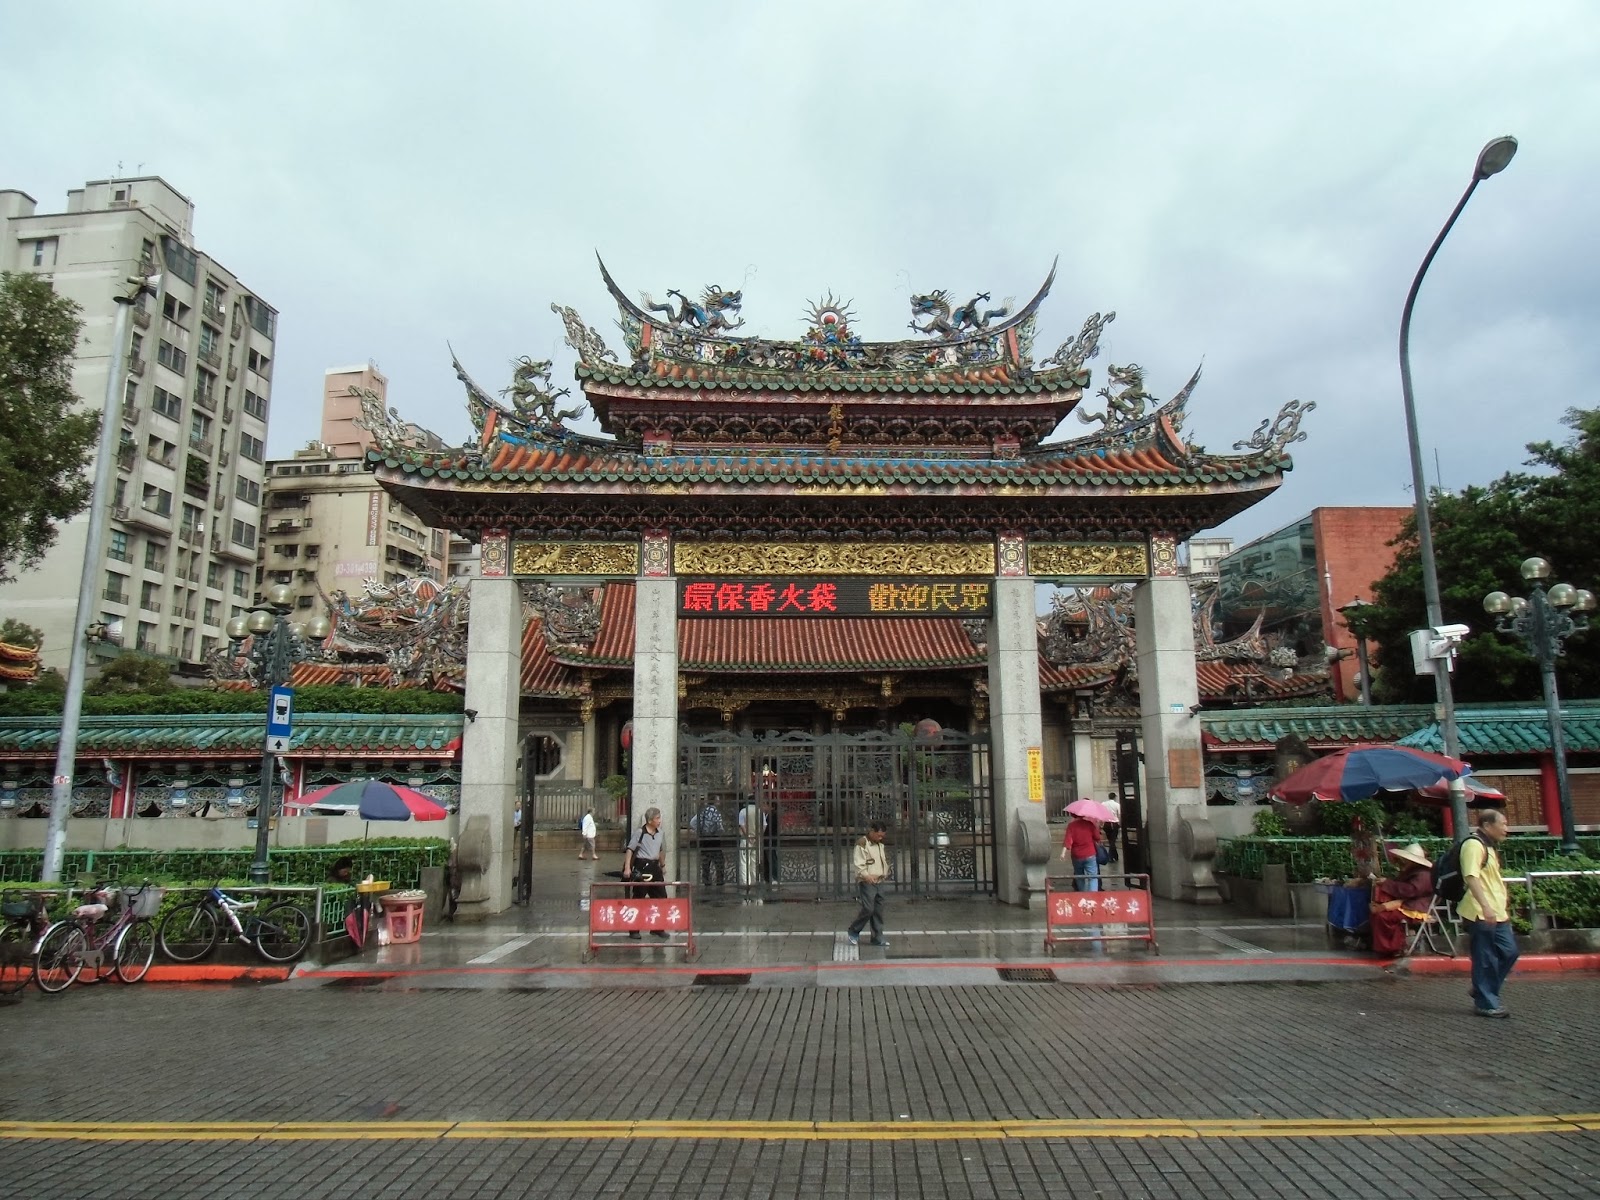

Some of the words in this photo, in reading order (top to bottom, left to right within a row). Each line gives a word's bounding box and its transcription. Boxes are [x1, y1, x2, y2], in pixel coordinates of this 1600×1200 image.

[683, 583, 837, 611] 環保香火袋
